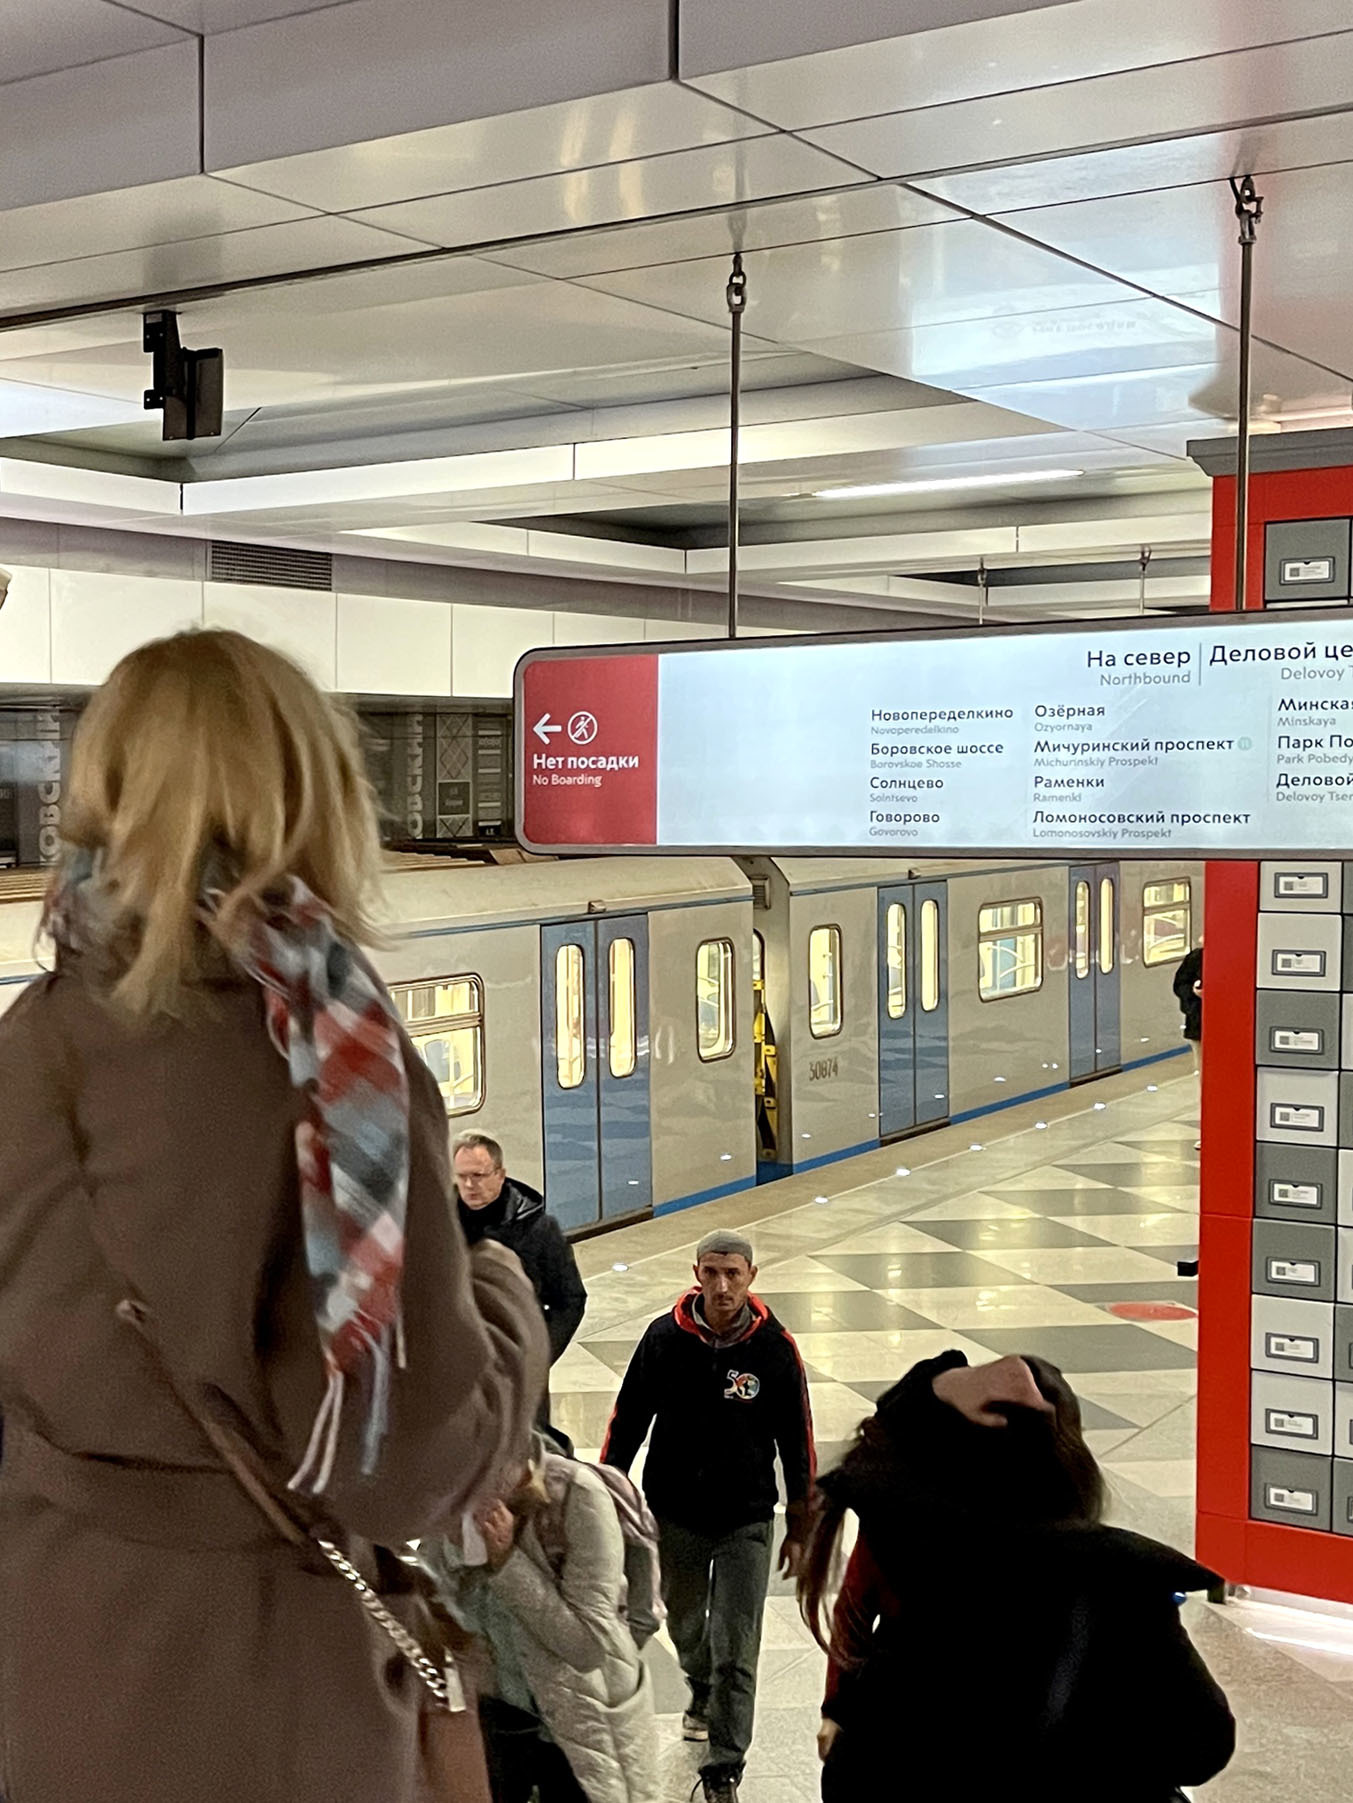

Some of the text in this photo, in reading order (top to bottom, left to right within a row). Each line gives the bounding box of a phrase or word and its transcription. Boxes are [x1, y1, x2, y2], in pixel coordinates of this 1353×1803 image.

[1087, 649, 1192, 669] На север
[1209, 641, 1317, 666] Деловой
[1099, 670, 1192, 687] Northbound
[1280, 665, 1345, 682] Delovoy
[871, 708, 1014, 723] Новопеределкино
[1034, 703, 1105, 719] Озёрная
[1033, 721, 1093, 733] Ozyornaya
[1277, 715, 1337, 728] Minskaya
[870, 724, 960, 736] Novoperedelkino
[871, 742, 1004, 757] Боровское шоссе
[1033, 737, 1234, 756] Мичуринский проспект
[1277, 734, 1324, 751] Парк
[533, 753, 640, 771] Нет посадки
[870, 758, 962, 769] Borovskoe Shosse
[1033, 755, 1159, 768] Michurinskiy Prospekt
[1276, 753, 1305, 765] Park
[532, 773, 603, 788] No Boarding
[869, 776, 944, 791] Солнцево
[1033, 775, 1105, 789] Раменки
[869, 792, 919, 803] Solntsevo
[1033, 792, 1082, 803] Ramenki
[1275, 791, 1324, 804] Delovoy
[869, 810, 941, 826] Говорово
[1032, 810, 1251, 827] Ломоносовский проспект
[1032, 827, 1172, 840] Lomonosovskiy Prospekt
